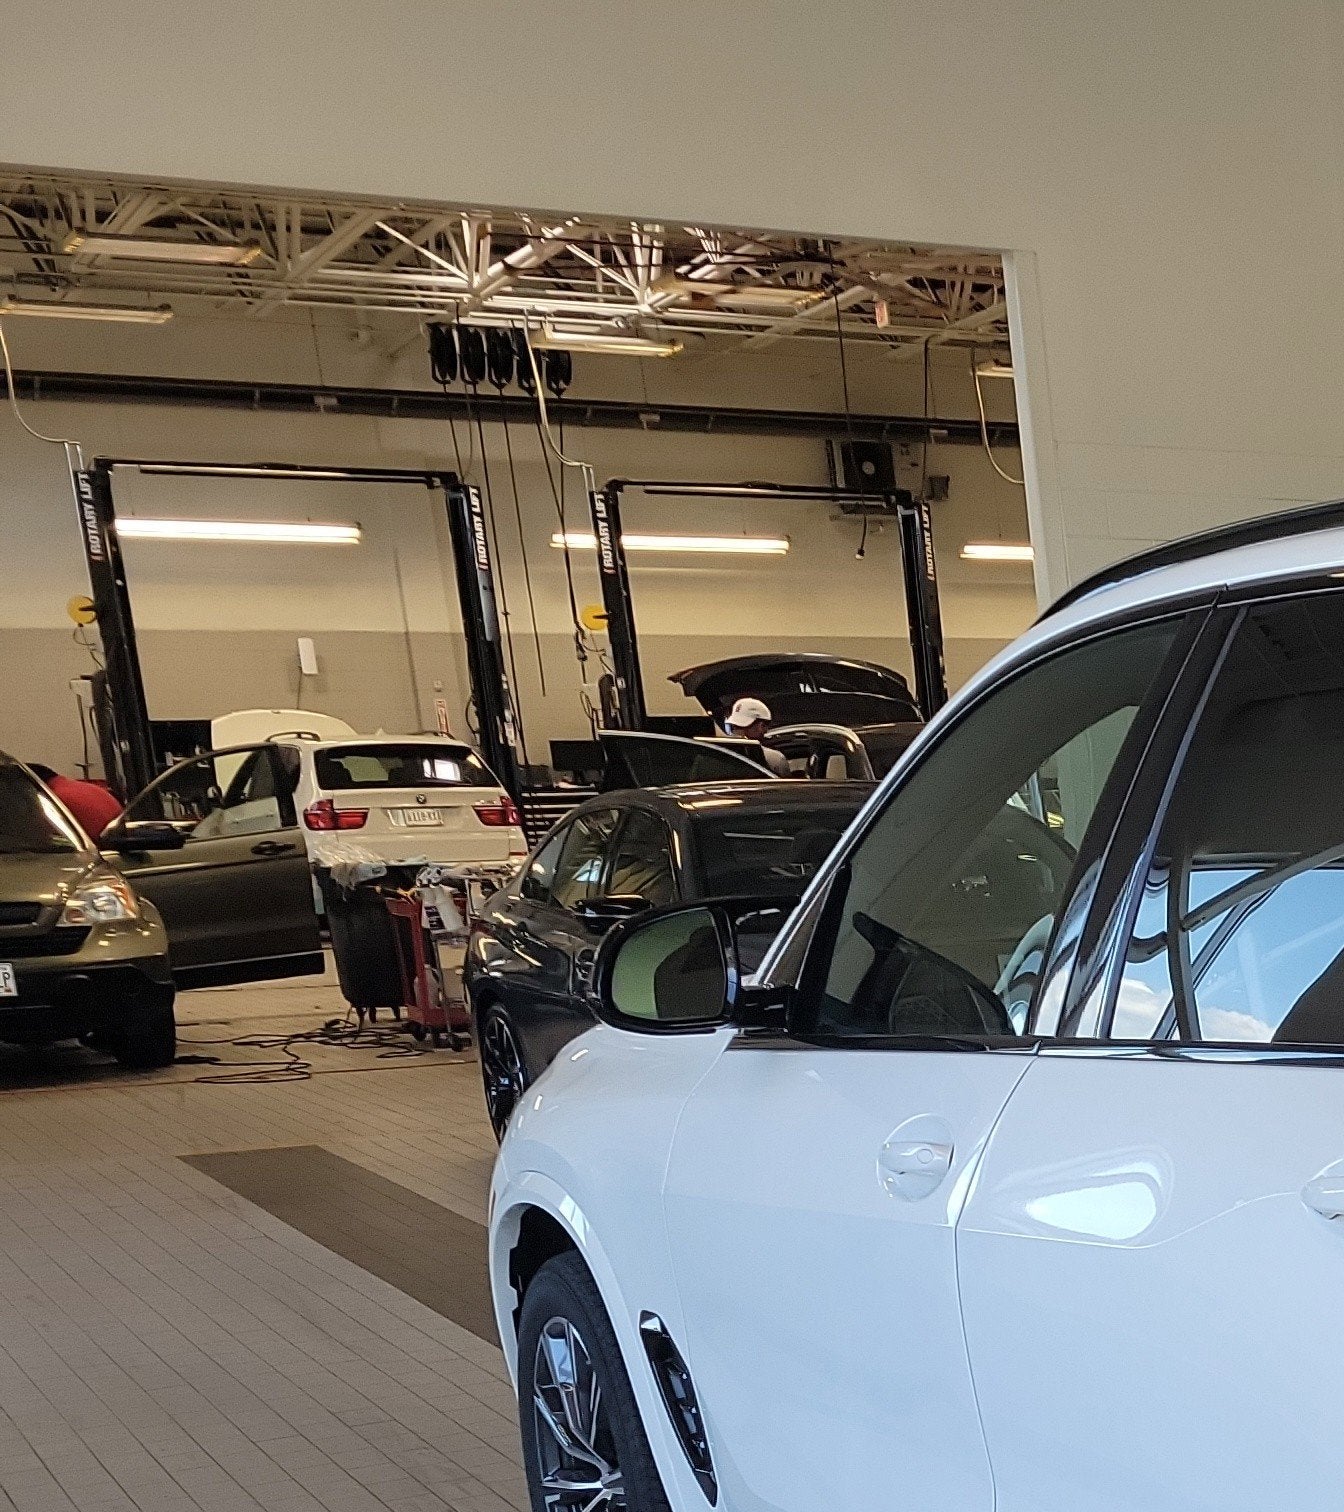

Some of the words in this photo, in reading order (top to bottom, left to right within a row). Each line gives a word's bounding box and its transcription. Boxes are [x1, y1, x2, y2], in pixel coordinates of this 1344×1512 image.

[77, 472, 93, 499] LIFT
[468, 486, 481, 513] LIFT
[593, 492, 608, 518] LIFT
[82, 501, 103, 554] ROTARY
[472, 514, 488, 564] ROTARY
[597, 520, 614, 568] ROTARY
[923, 529, 935, 576] ROTARY
